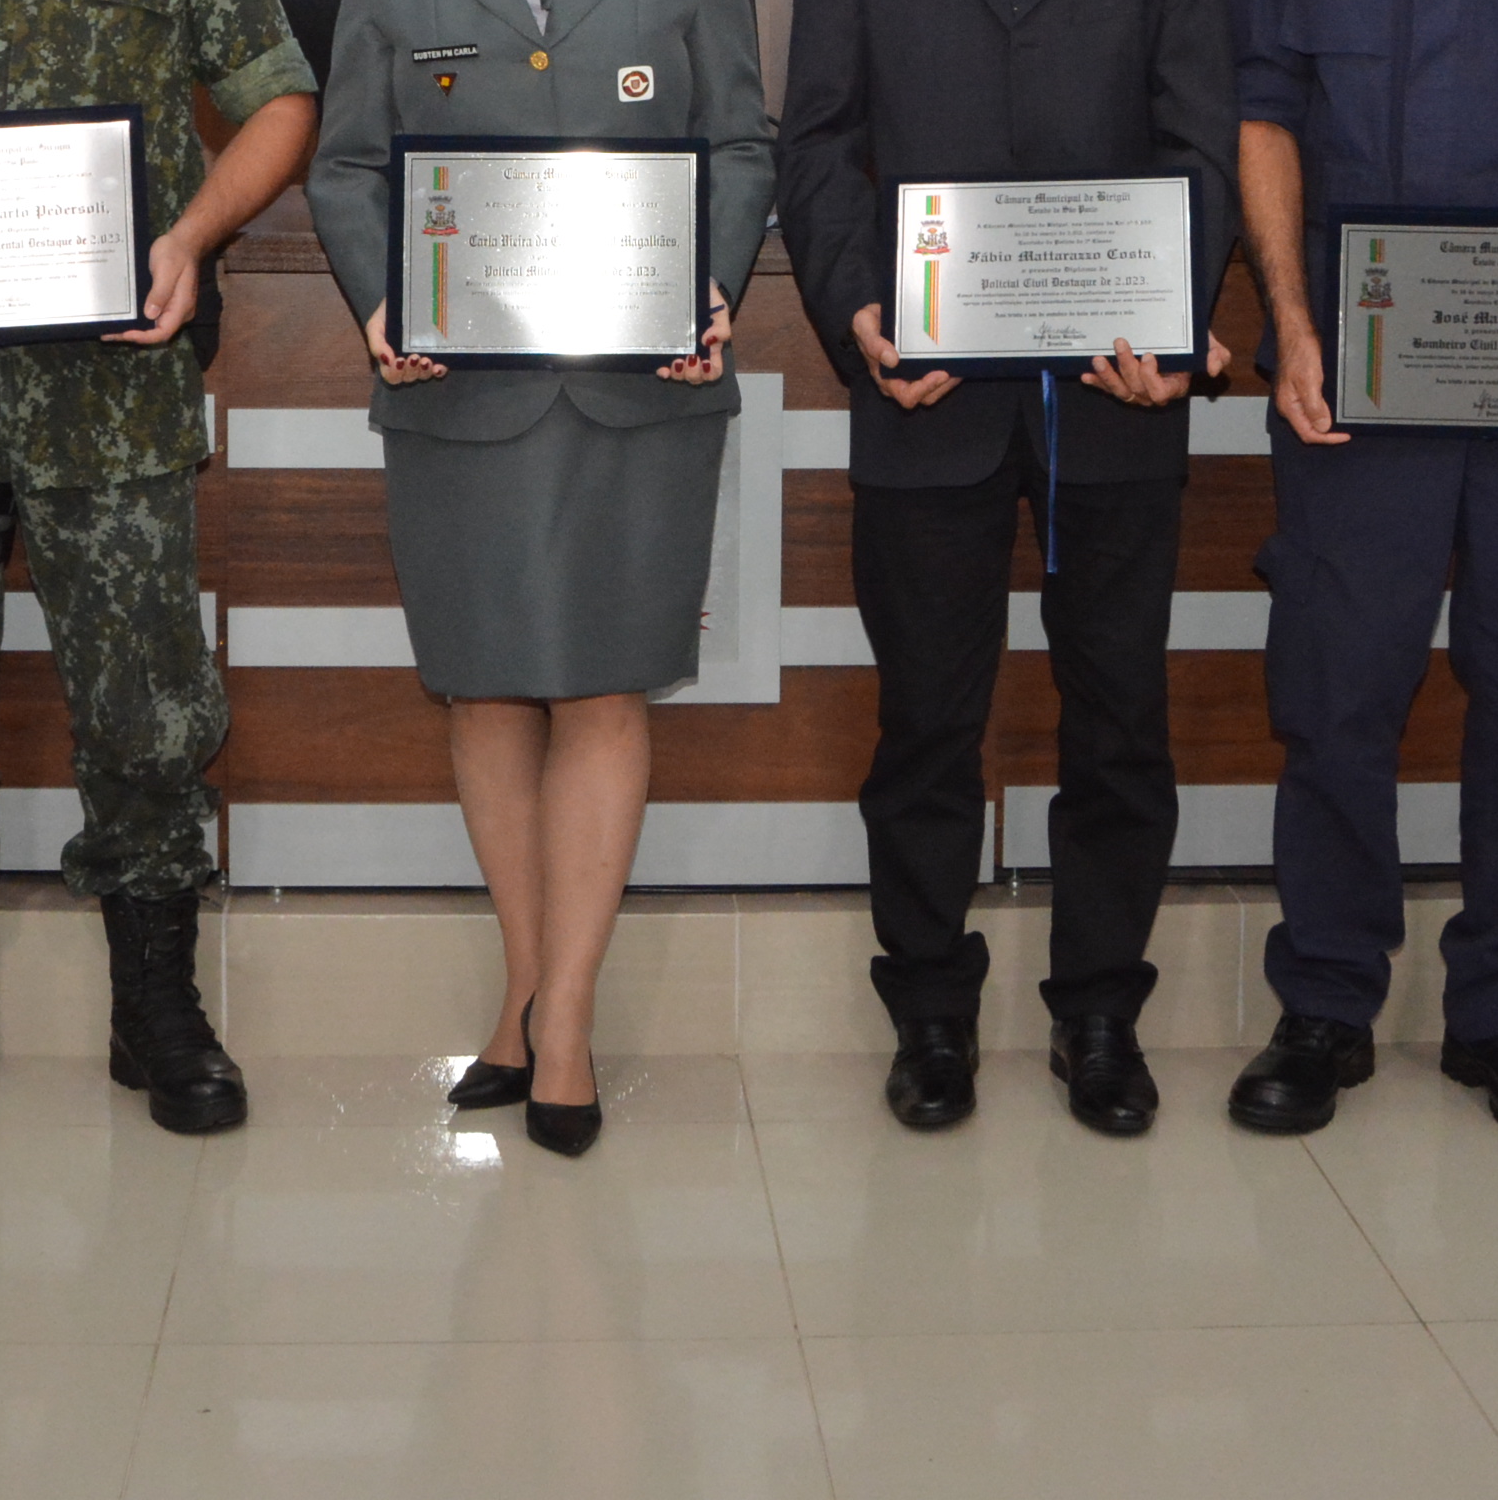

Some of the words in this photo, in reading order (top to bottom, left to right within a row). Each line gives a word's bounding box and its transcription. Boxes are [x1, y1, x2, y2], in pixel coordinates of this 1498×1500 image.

[454, 47, 477, 56] CARLA
[995, 194, 1031, 205] Câmara
[1035, 193, 1081, 205] Municipal
[1084, 193, 1093, 202] de
[77, 235, 87, 245] de
[469, 234, 497, 247] Carla
[501, 235, 532, 247] Vieira
[536, 235, 548, 247] da
[1440, 241, 1475, 254] Câmara
[968, 251, 1012, 263] Fábio
[1018, 250, 1101, 262] Mattarazzo
[1107, 248, 1156, 260] Costa,
[484, 265, 522, 278] Policial
[981, 279, 1019, 290] Policial
[1023, 278, 1048, 288] Civil
[1051, 278, 1096, 289] Destaque
[1101, 277, 1111, 286] de
[1115, 277, 1149, 286] 2.023.
[1432, 310, 1468, 324] José
[1413, 337, 1466, 350] Bombeiro
[1470, 338, 1497, 351] Civil
